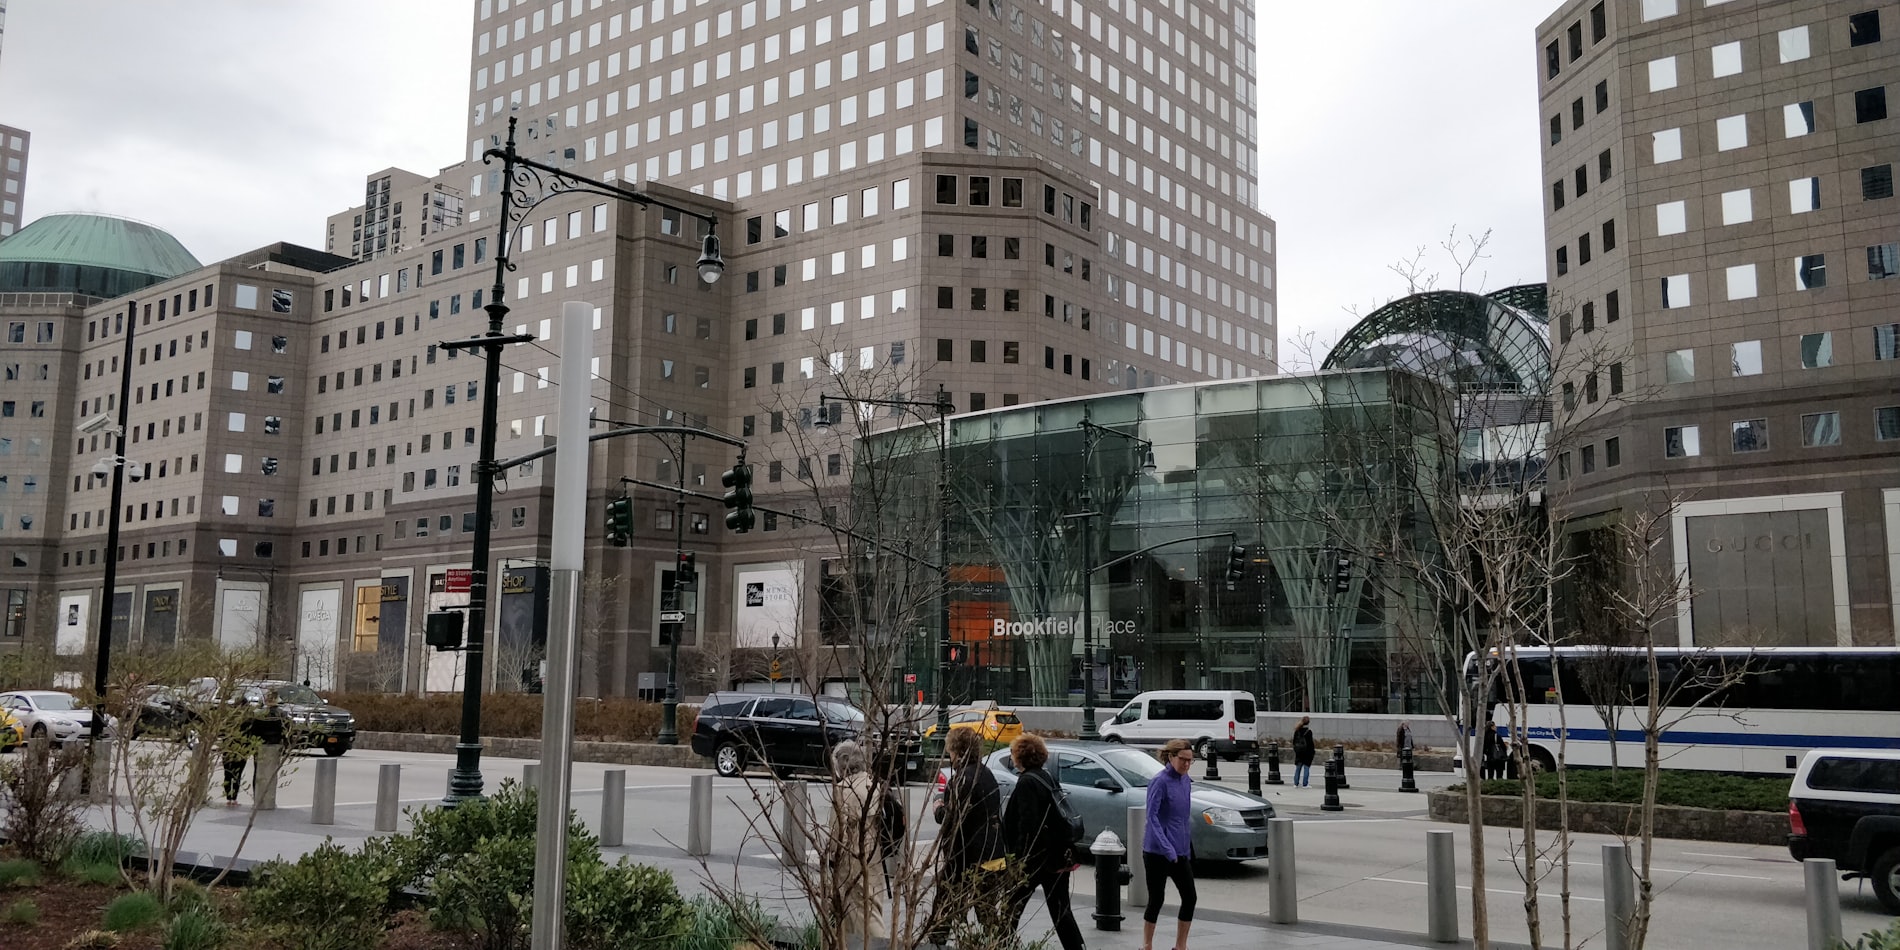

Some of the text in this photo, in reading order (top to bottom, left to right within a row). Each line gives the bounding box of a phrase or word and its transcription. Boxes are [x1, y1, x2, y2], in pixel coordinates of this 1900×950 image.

[1707, 532, 1811, 552] GUCCI
[503, 575, 525, 587] SHOP
[380, 585, 398, 596] STYLE
[307, 611, 331, 621] OMEGA
[993, 615, 1136, 637] Brookfield Place
